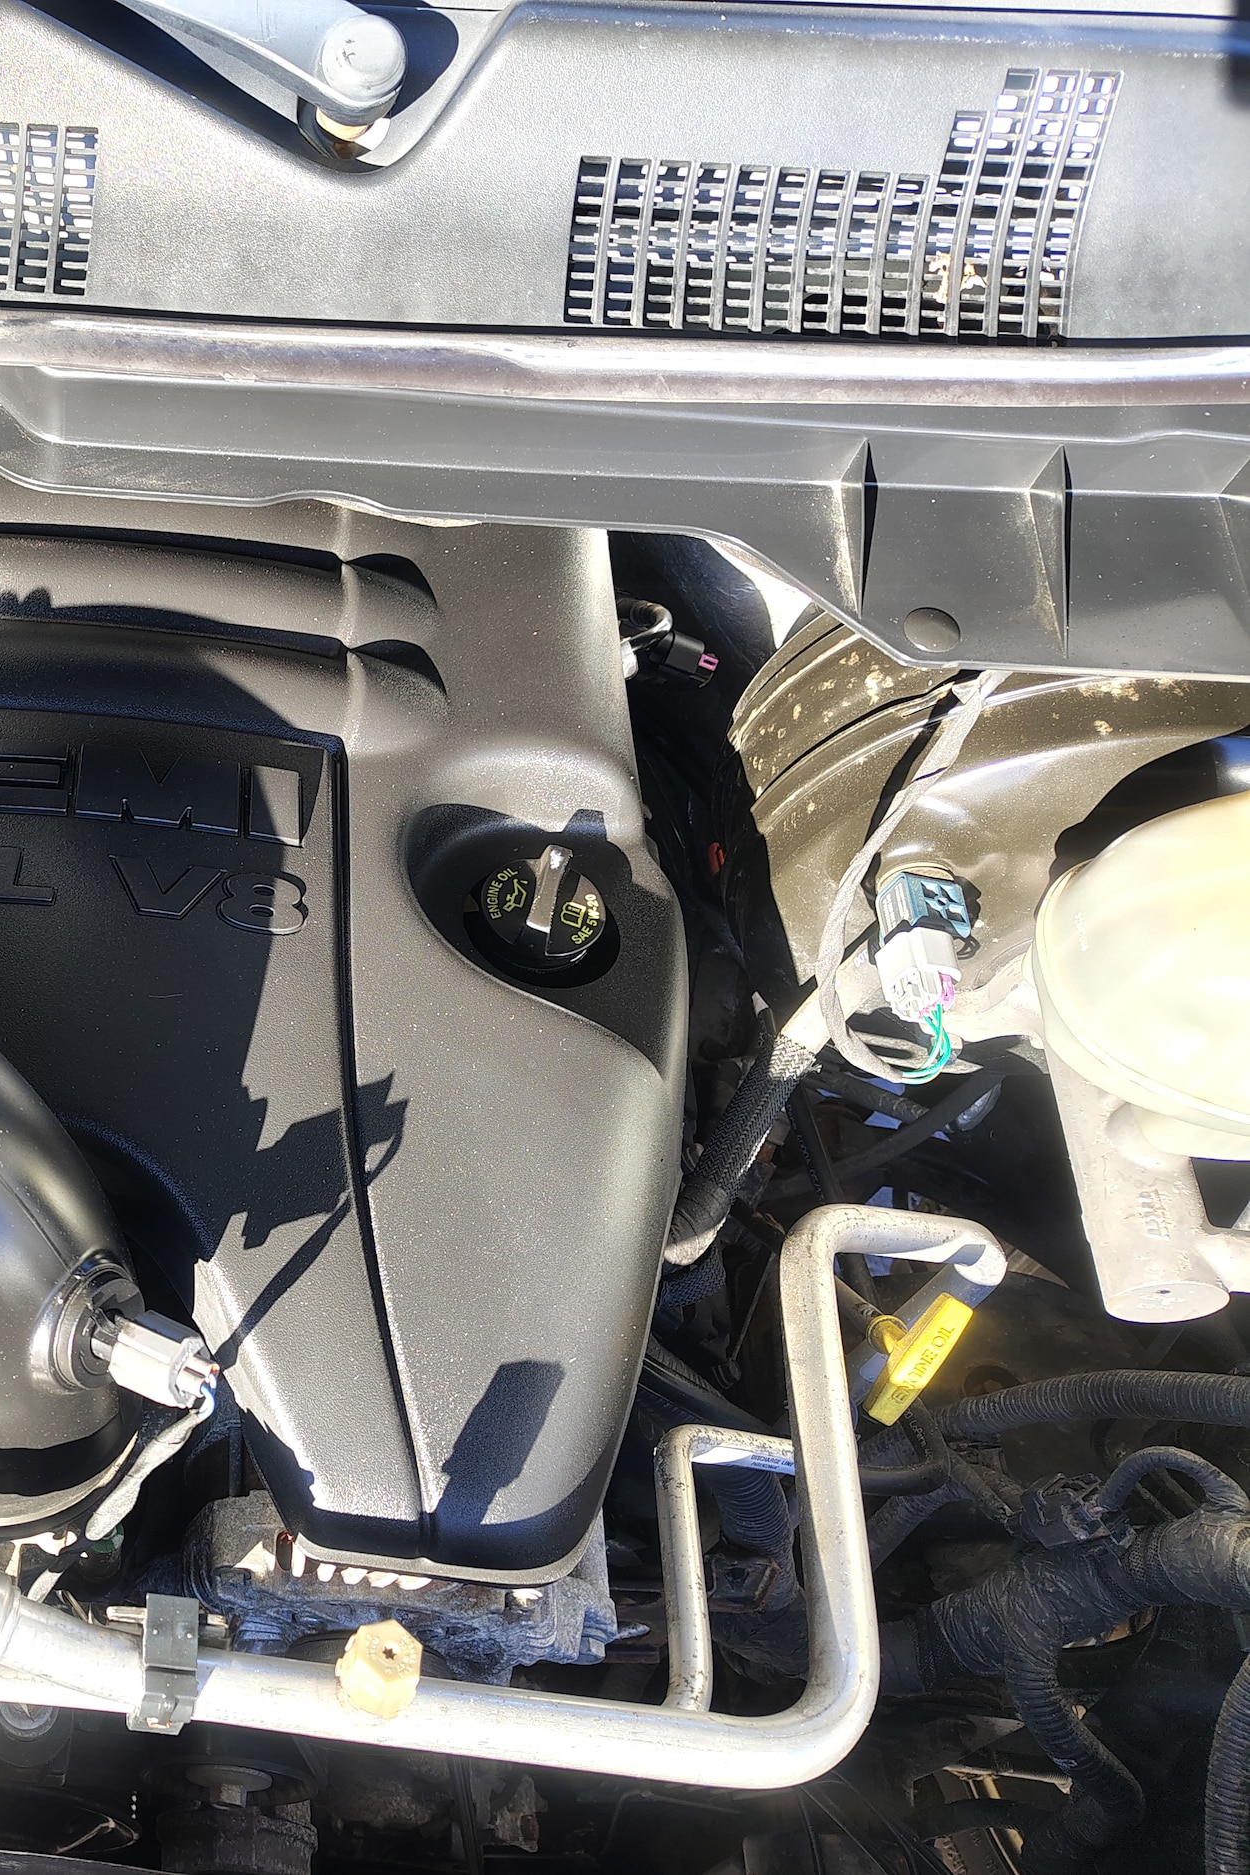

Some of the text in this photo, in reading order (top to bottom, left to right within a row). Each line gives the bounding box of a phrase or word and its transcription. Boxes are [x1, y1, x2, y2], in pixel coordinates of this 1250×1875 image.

[108, 853, 309, 935] V8
[486, 867, 518, 920] ENGINE OIL
[571, 893, 599, 945] SAE 5W-20
[933, 1327, 955, 1348] OIL
